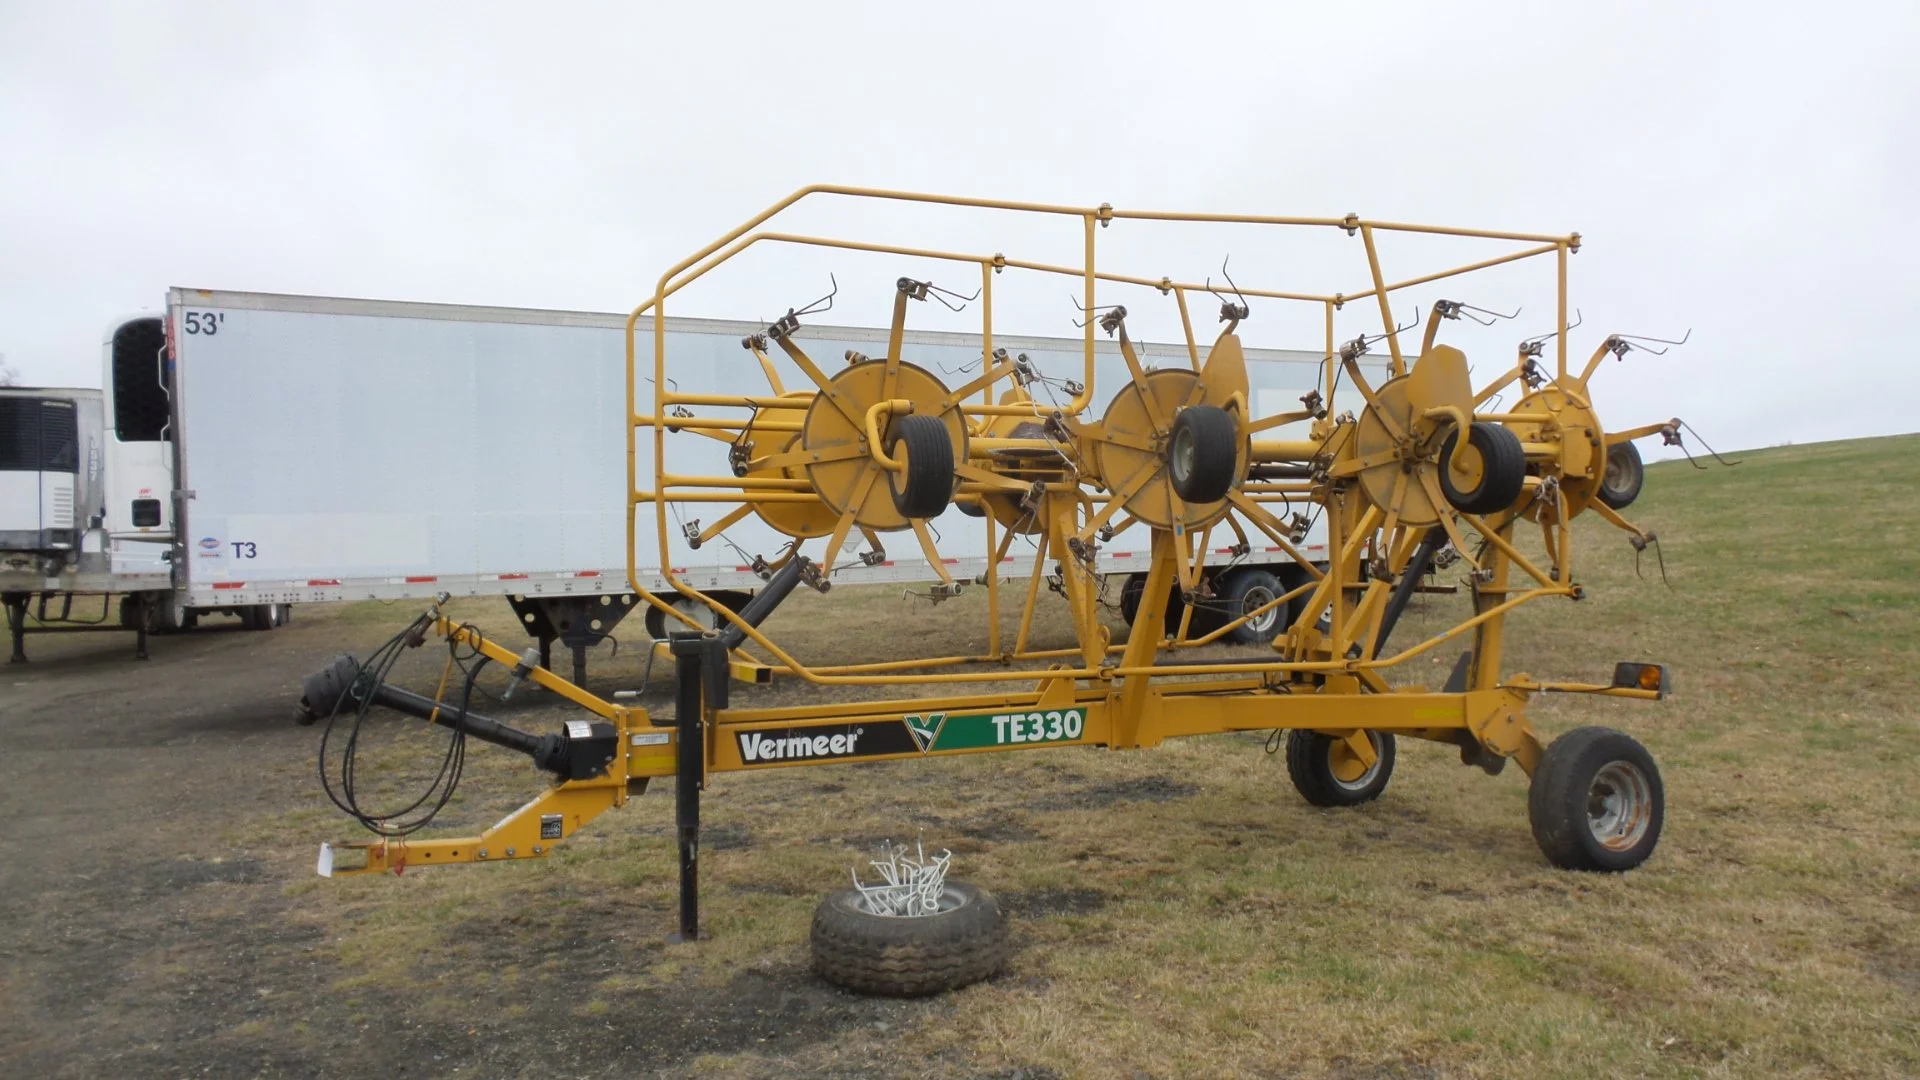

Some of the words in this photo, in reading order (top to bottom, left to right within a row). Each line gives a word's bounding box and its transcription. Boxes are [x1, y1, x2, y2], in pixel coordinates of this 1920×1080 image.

[185, 311, 225, 336] 53'
[230, 541, 257, 559] T3
[991, 710, 1082, 744] TE330
